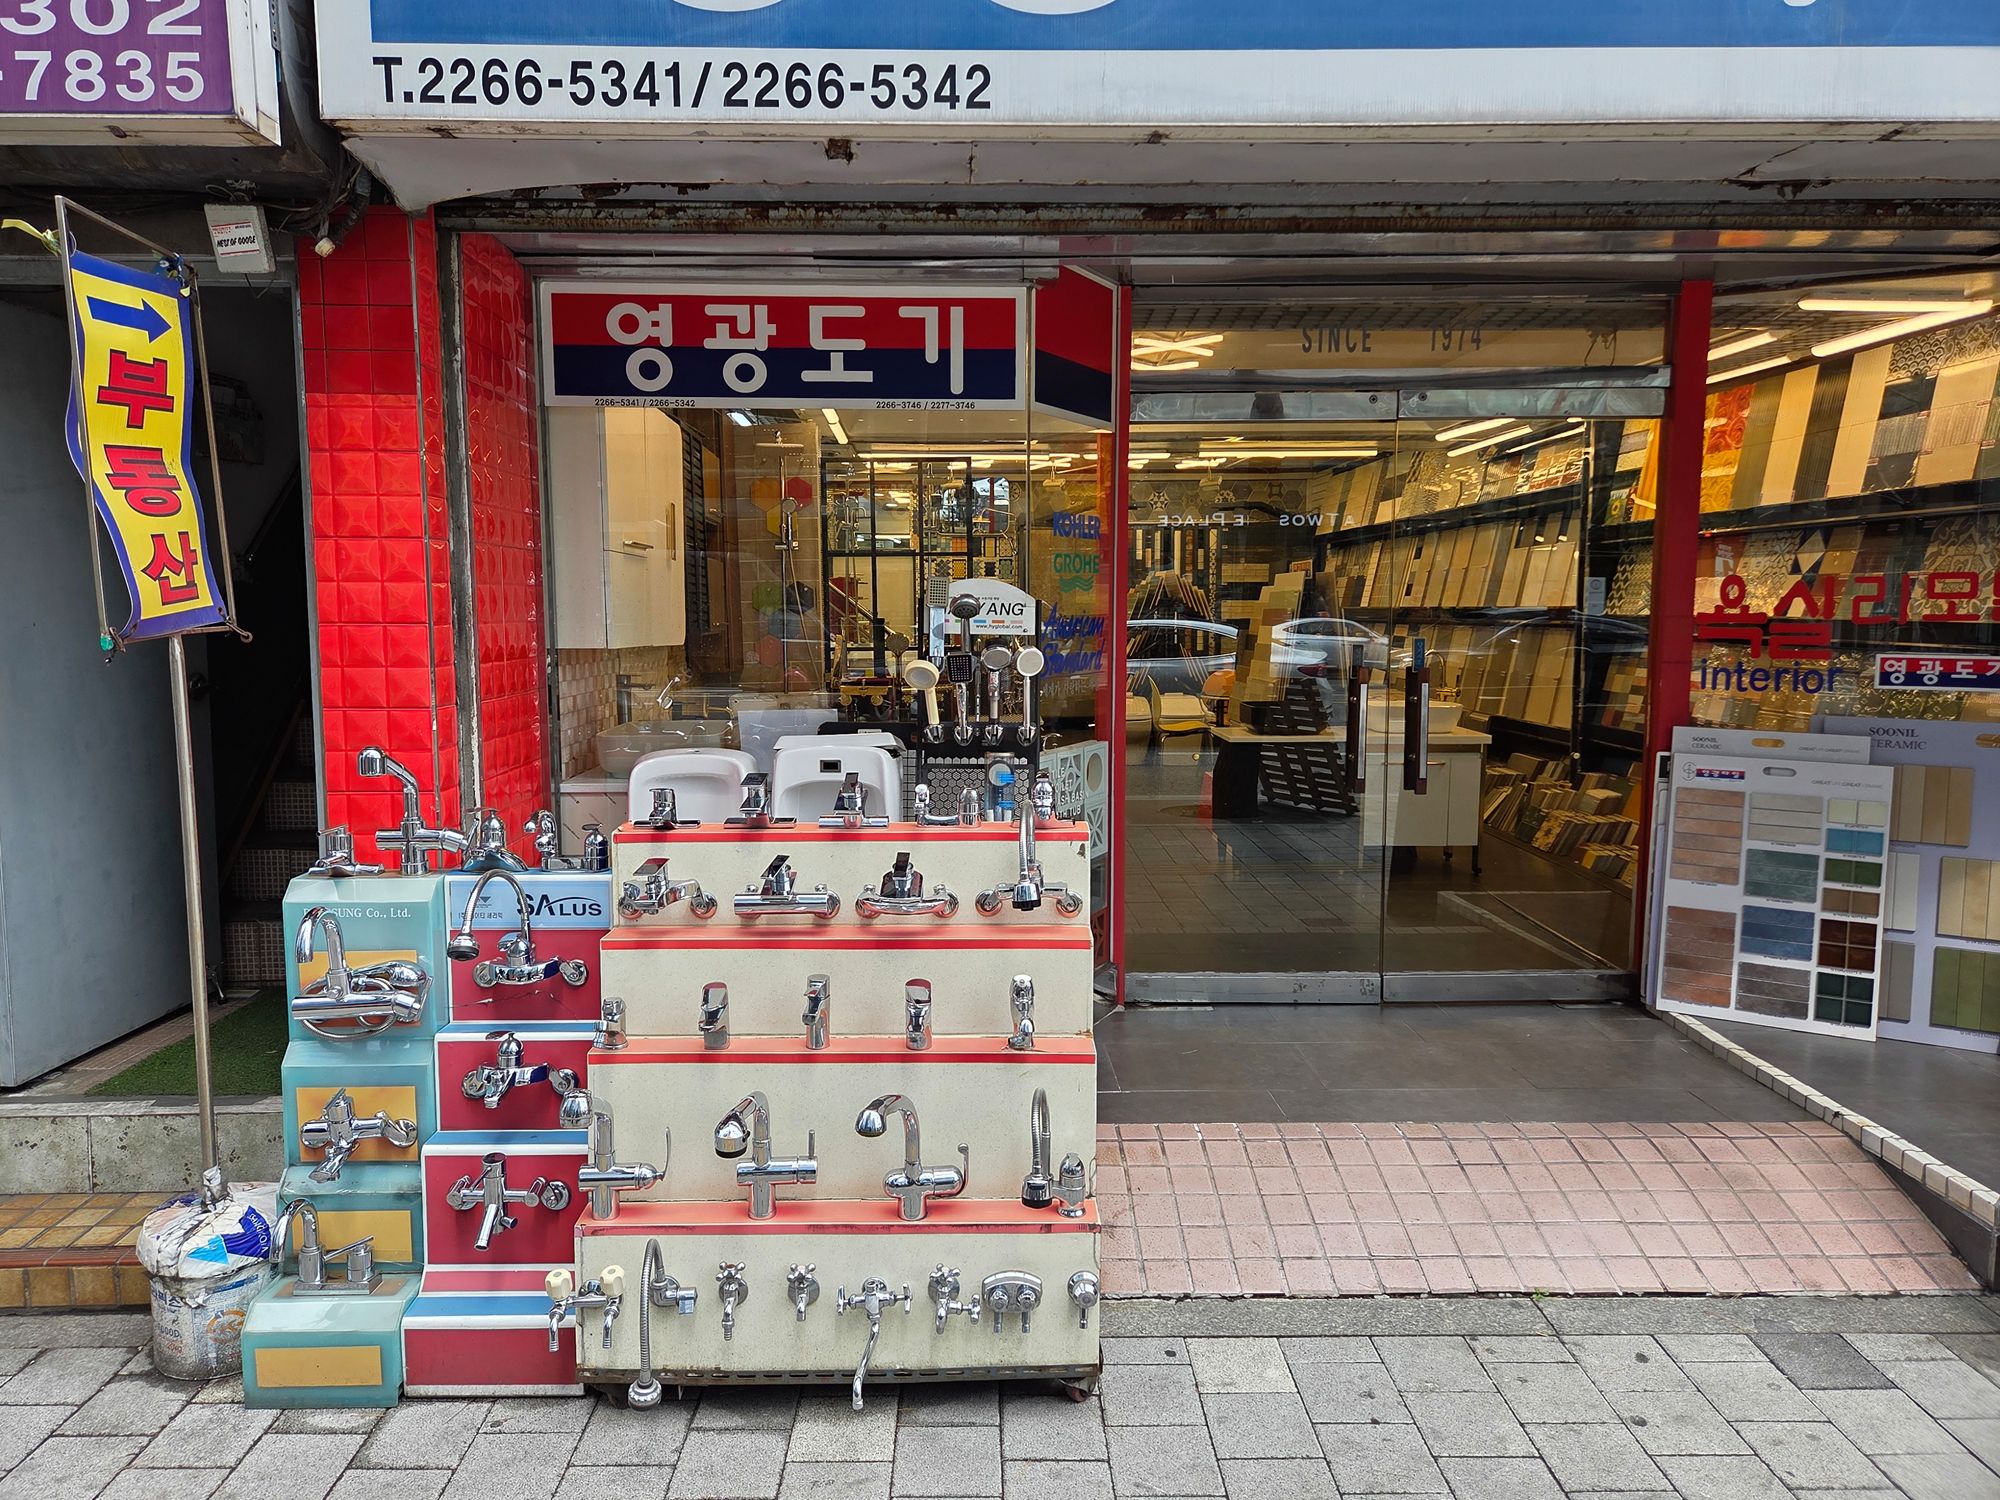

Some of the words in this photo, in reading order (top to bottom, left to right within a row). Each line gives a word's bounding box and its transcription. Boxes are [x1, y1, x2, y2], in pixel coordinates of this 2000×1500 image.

[0, 50, 205, 102] 7835
[606, 302, 964, 395] 영광도기
[1302, 324, 1371, 353] SINCE
[1431, 320, 1482, 352] 1974
[595, 399, 639, 407] 2266-5341
[876, 401, 921, 409] 2266-3746
[97, 348, 200, 606] 부동산
[1052, 511, 1101, 540] KOHLER
[1053, 553, 1101, 575] GROHE
[1694, 573, 2000, 660] 욕실리모
[1700, 658, 1843, 694] interior
[1868, 726, 1919, 738] SOONIL
[1055, 779, 1073, 793] OILET
[366, 908, 387, 919] Co.,
[390, 908, 411, 918] Ltd.
